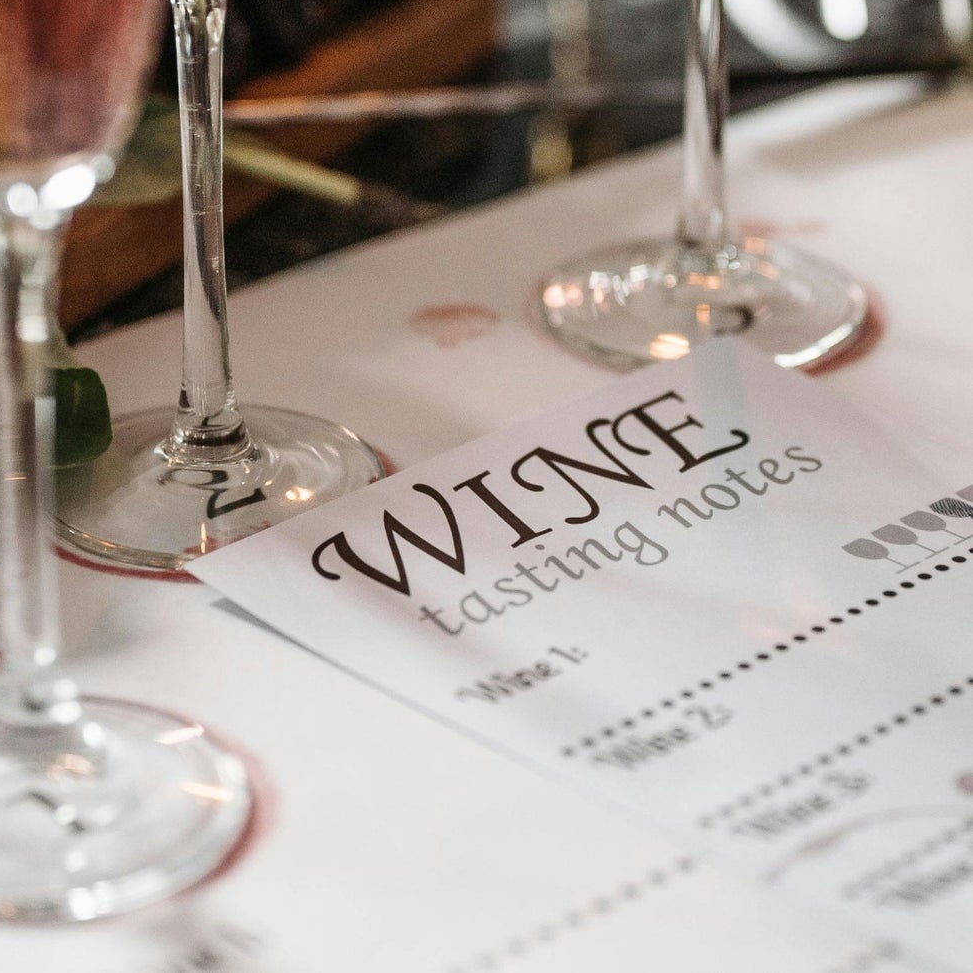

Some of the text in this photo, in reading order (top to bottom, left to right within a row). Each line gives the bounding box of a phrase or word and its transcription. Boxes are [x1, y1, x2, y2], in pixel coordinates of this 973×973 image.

[311, 390, 750, 597] WINE
[418, 445, 823, 637] tasting notes
[453, 660, 562, 705] Wine
